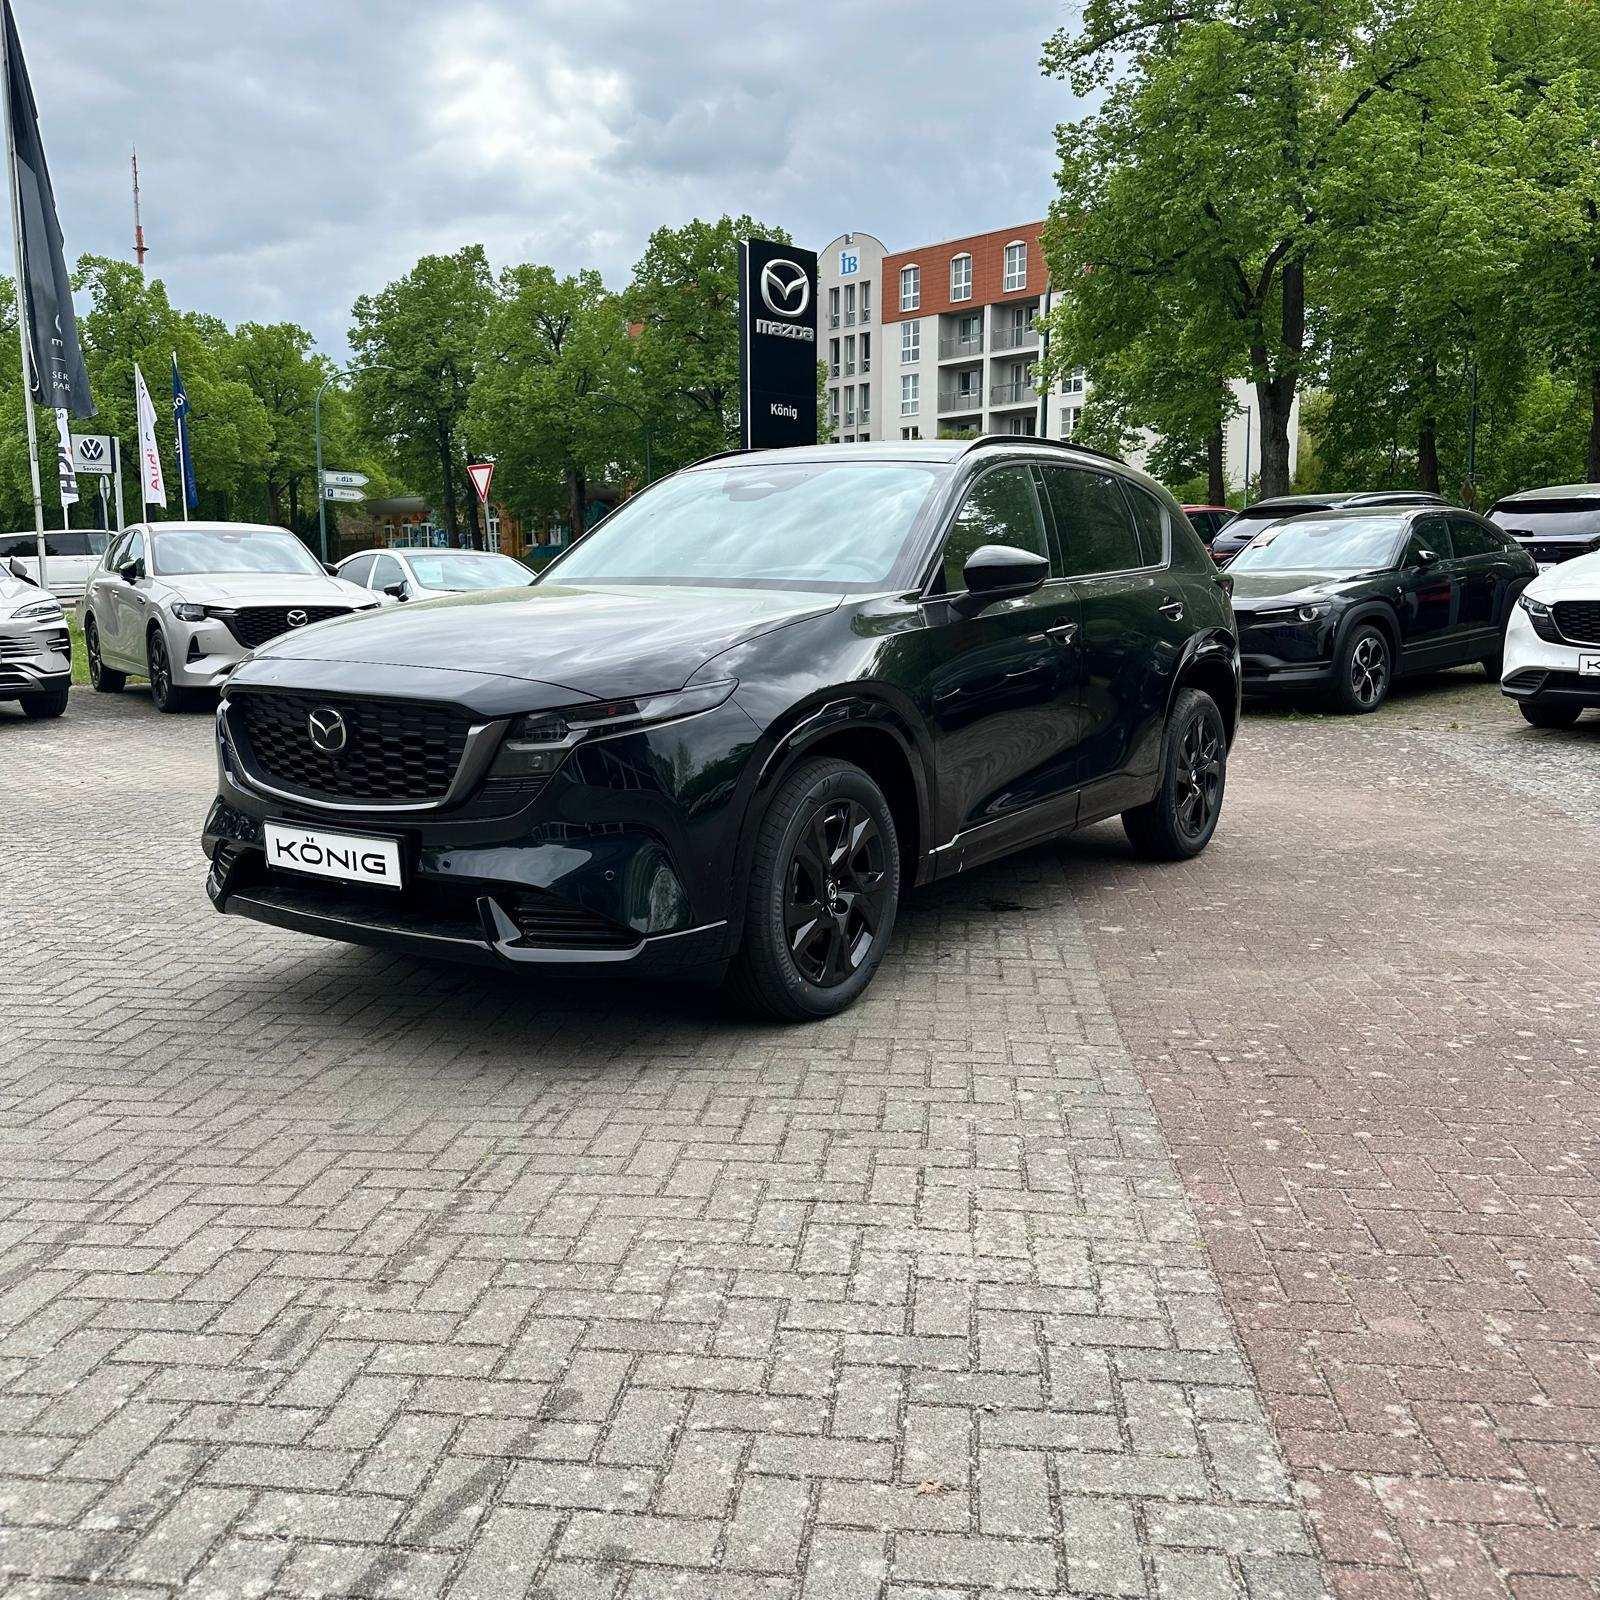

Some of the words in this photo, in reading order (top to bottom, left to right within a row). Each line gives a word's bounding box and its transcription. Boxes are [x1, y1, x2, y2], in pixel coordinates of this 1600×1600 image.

[770, 403, 798, 420] König
[147, 448, 160, 491] Audi
[276, 836, 387, 876] KÖNIG
